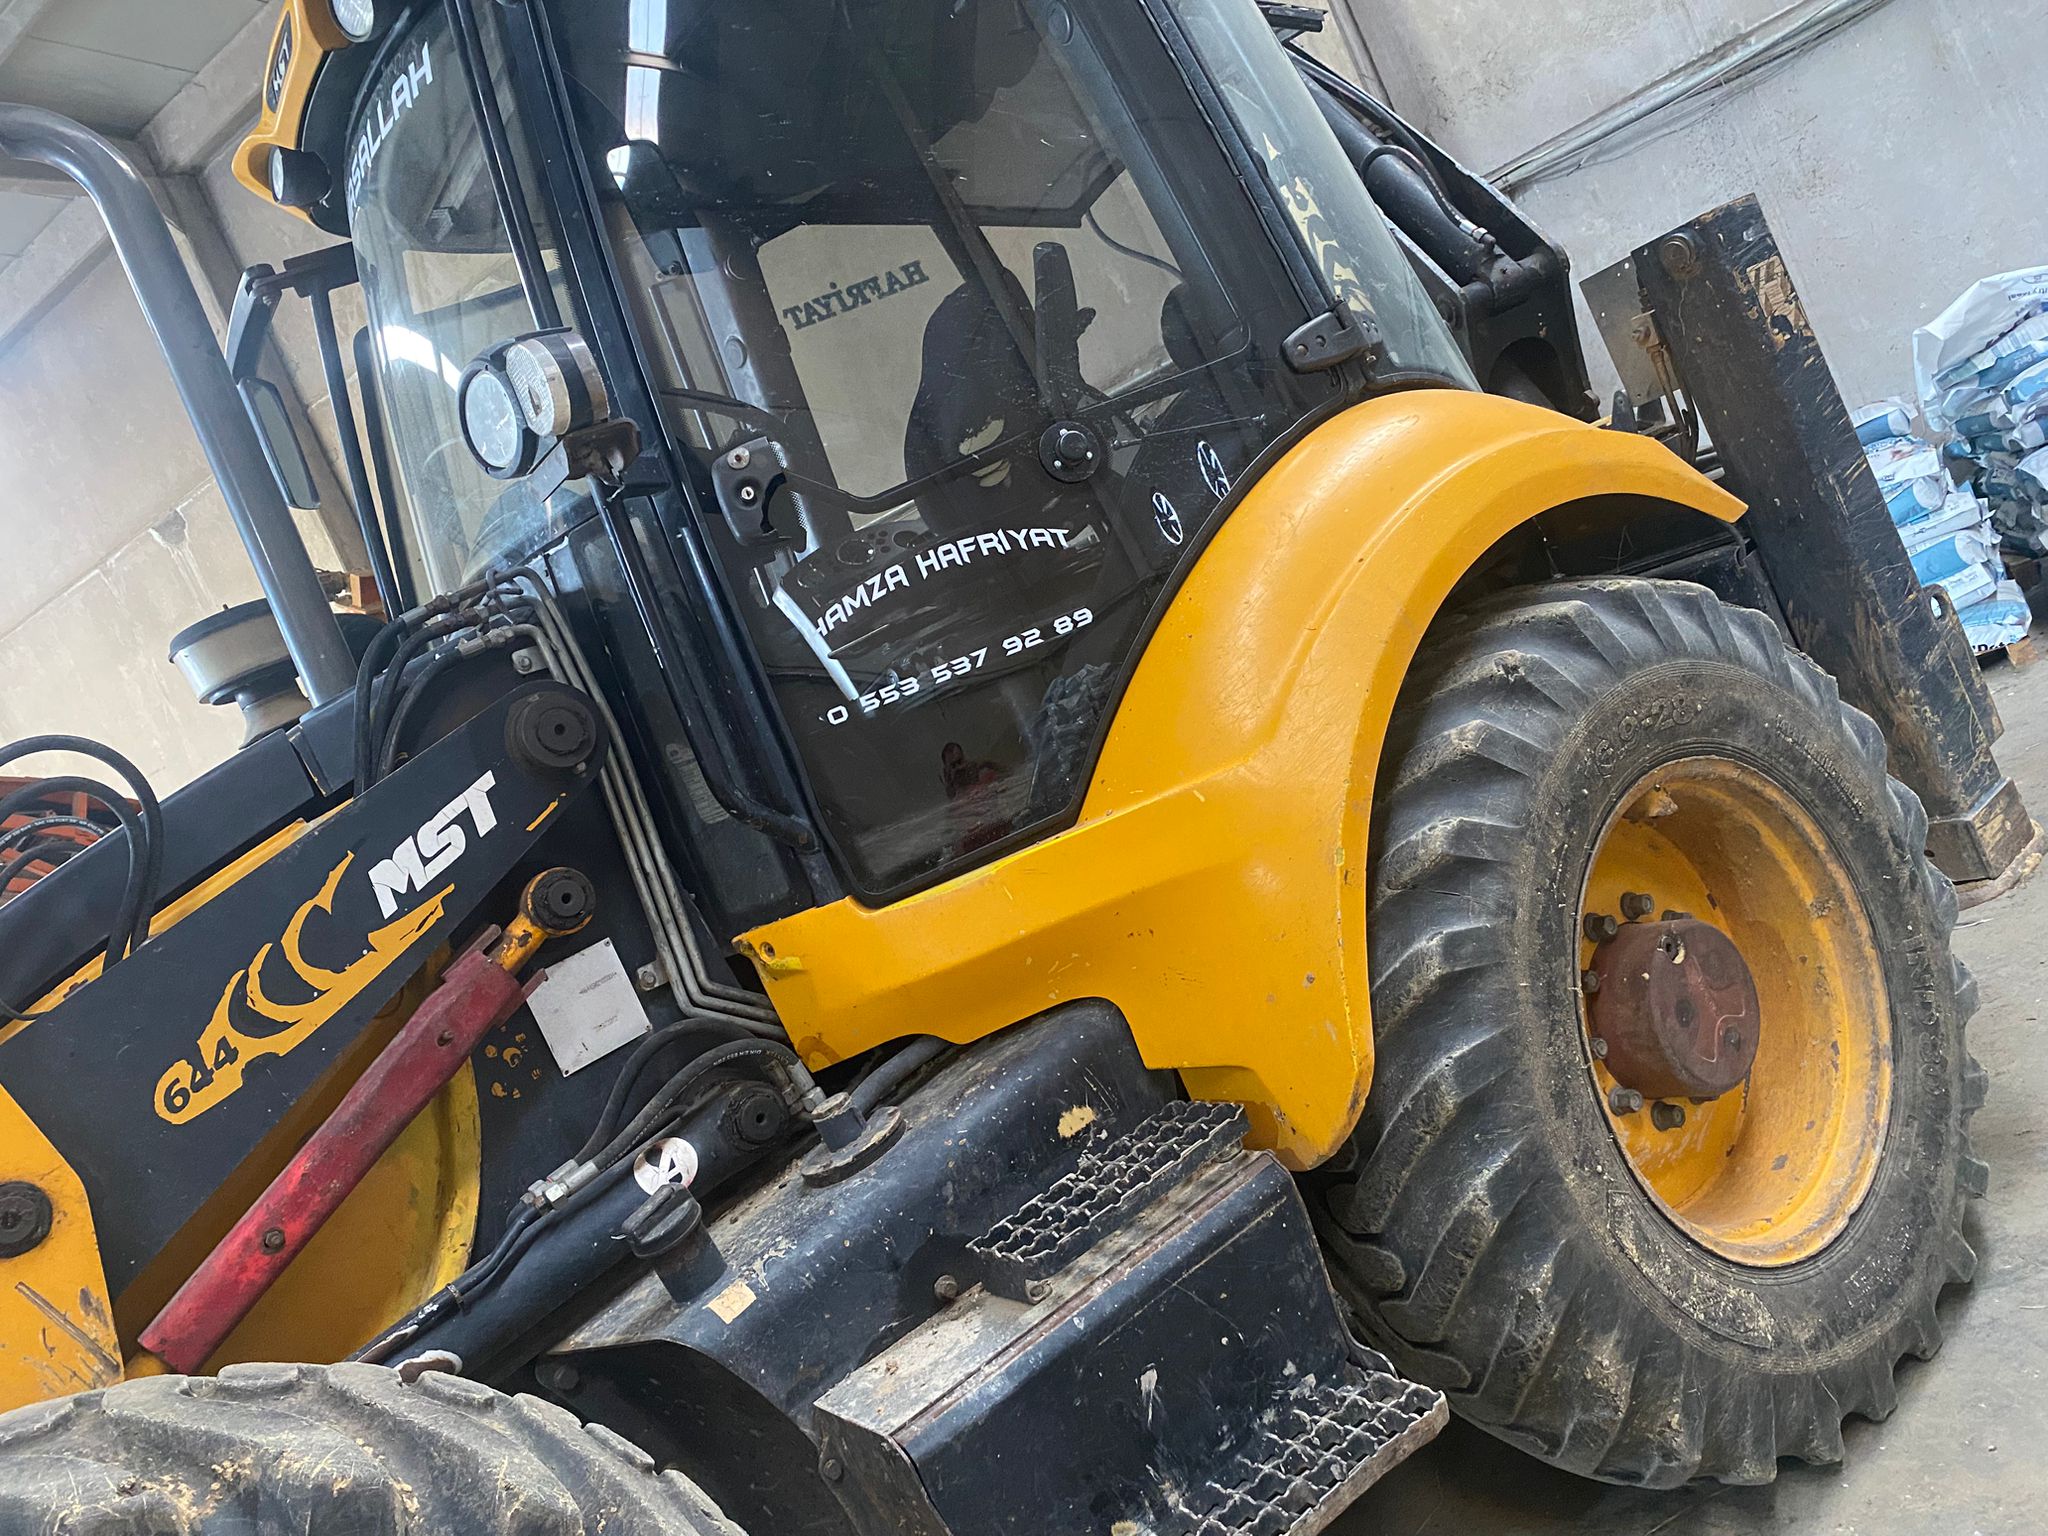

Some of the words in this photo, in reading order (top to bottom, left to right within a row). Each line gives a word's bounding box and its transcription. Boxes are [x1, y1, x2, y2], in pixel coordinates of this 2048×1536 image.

[814, 564, 910, 637] HAMZA
[915, 528, 1070, 580] HAFRIYAT
[827, 705, 849, 725] 0
[859, 677, 920, 712] 553
[931, 647, 988, 684] 537
[1002, 628, 1045, 657] 92
[1053, 607, 1095, 635] 89
[368, 770, 498, 919] MST
[164, 1035, 239, 1114] 644
